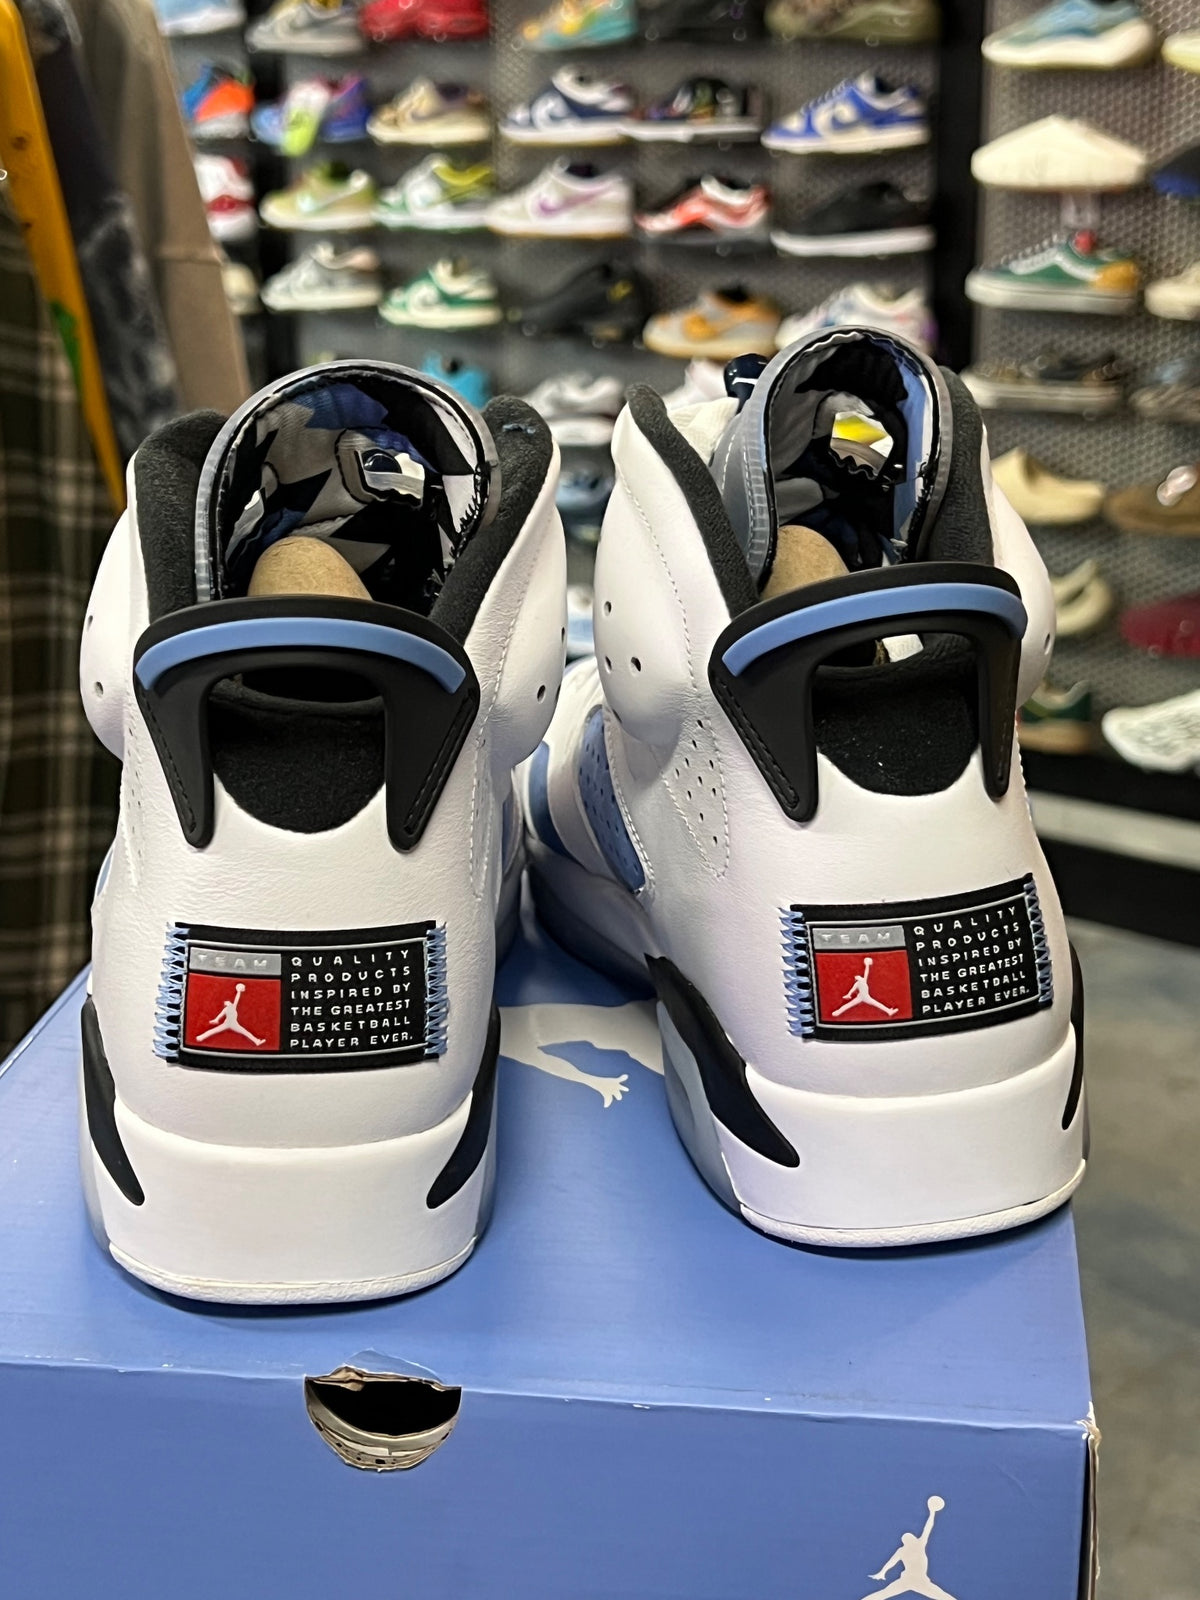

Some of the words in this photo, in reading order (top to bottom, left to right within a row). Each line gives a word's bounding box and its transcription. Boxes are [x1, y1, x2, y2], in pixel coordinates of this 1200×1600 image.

[913, 906, 1015, 935] QUALITY
[821, 933, 890, 943] TEAM
[916, 922, 1019, 951] PRODUCTS
[292, 950, 408, 966] QUALITY
[918, 946, 1000, 967] INSPIRED
[1007, 938, 1021, 950] BY
[198, 954, 267, 969] TEAM
[920, 971, 950, 983] THE
[958, 954, 1024, 977] GREATEST
[291, 966, 410, 983] PRODUCTS
[291, 987, 382, 1000] INSPIRED
[393, 982, 410, 993] BY
[921, 973, 1026, 999] BASKETBALL
[291, 1006, 322, 1016] THE
[331, 1000, 410, 1015] GREATEST
[922, 997, 986, 1013] PLAYER
[290, 1016, 410, 1032] BASKETBALL
[290, 1038, 358, 1048] PLAYER
